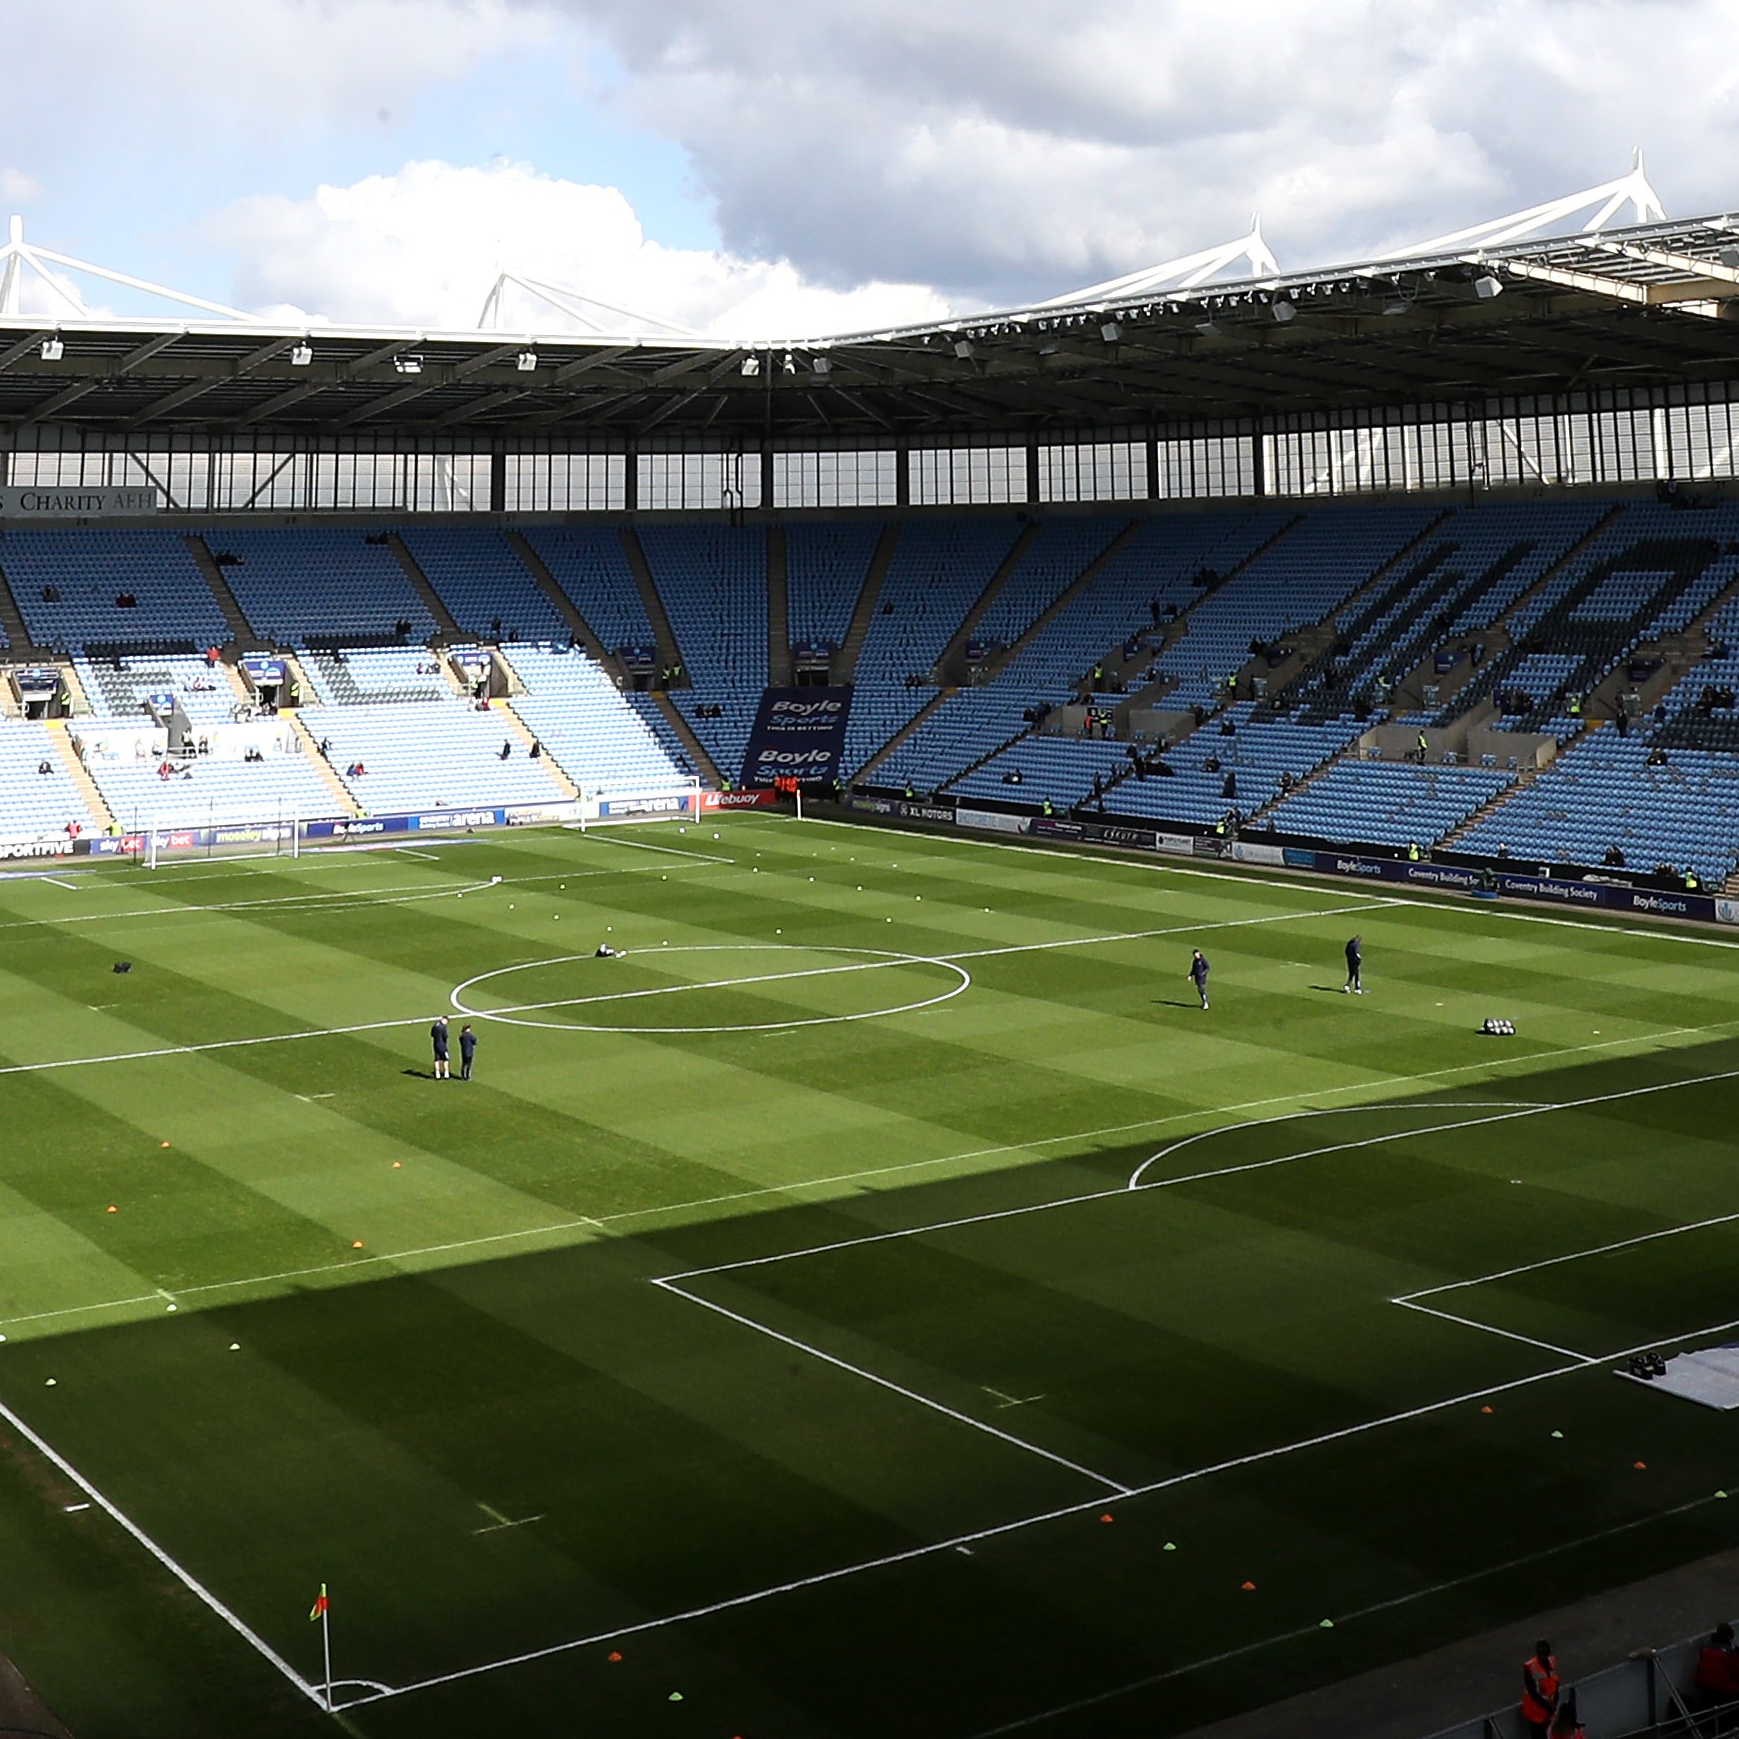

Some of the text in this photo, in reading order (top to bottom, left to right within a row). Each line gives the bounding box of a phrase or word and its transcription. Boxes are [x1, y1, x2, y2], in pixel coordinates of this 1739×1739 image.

[20, 492, 106, 511] CHARITY
[771, 699, 843, 716] Boyle
[770, 714, 838, 727] Sports
[758, 749, 832, 765] Boyle
[452, 810, 495, 827] arena
[909, 808, 953, 822] XL MOTORS
[171, 831, 192, 847] bet
[99, 840, 120, 855] sky
[1337, 860, 1382, 876] BoyleSports
[1408, 867, 1439, 882] Coventry
[1439, 869, 1467, 886] Building
[1505, 878, 1598, 901] Coventry Building Society
[1633, 894, 1687, 913] BoyleSports
